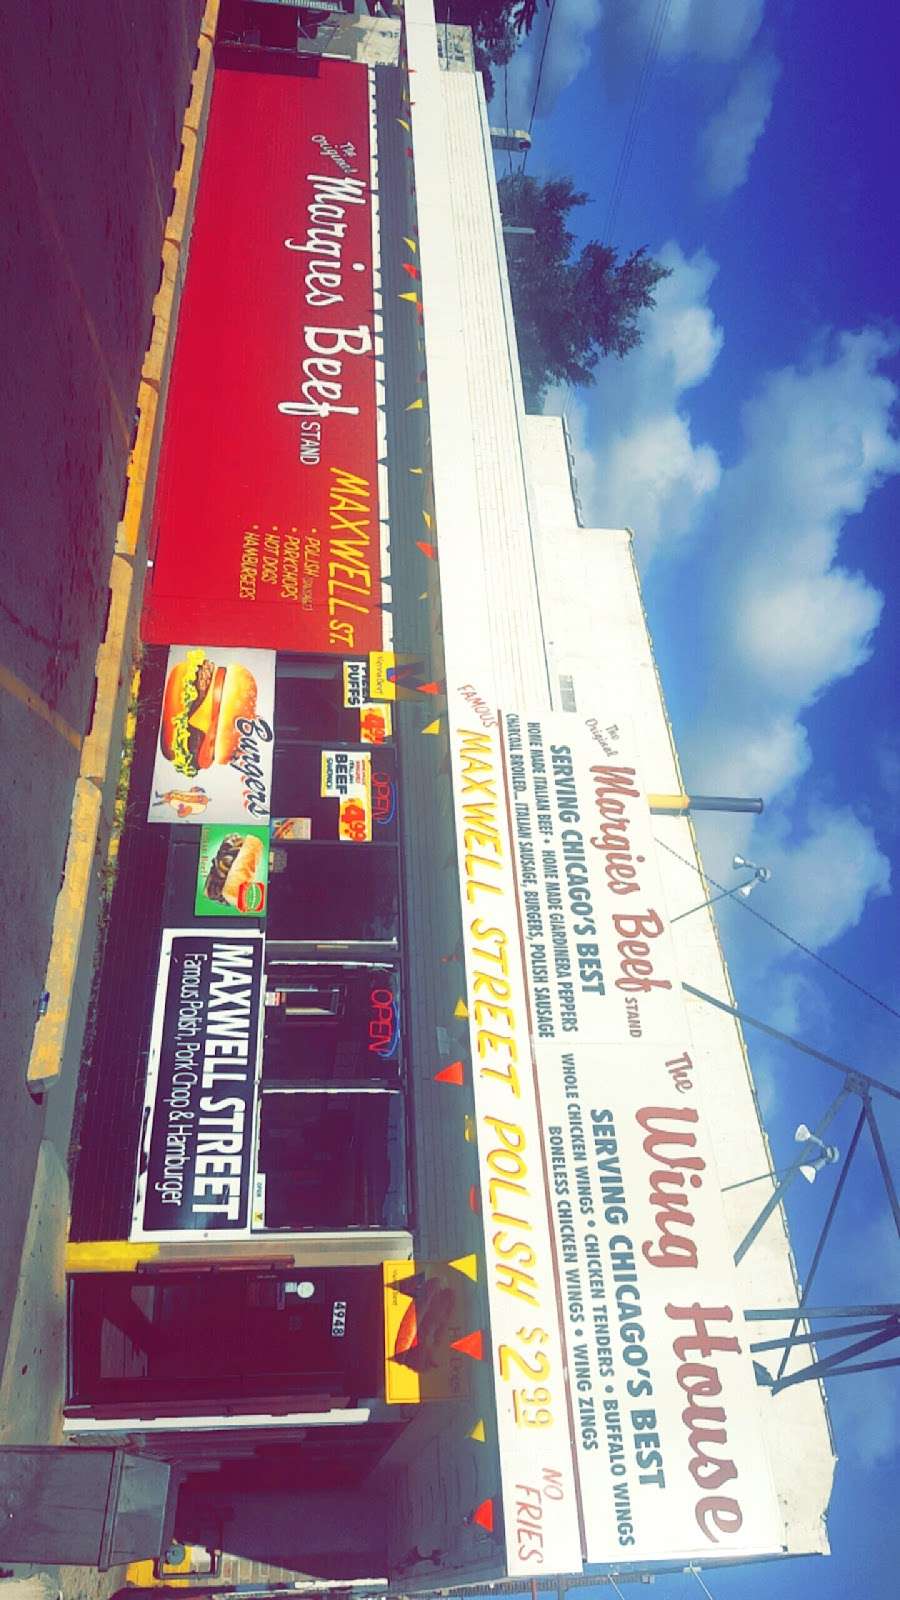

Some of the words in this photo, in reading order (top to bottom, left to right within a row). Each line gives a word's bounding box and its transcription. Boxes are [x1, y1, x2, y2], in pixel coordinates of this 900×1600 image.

[311, 134, 359, 173] Original
[284, 174, 367, 306] Margies
[277, 325, 372, 417] Beef
[300, 421, 321, 465] STAND
[239, 532, 260, 601] HAMBURGERS
[264, 533, 280, 556] HOT
[303, 536, 321, 577] POLISH
[327, 467, 371, 615] MAXWELL
[261, 556, 279, 585] DOGS
[280, 534, 301, 601] PORKCHOPS
[329, 619, 354, 648] ST.
[348, 665, 360, 705] PUFFS
[457, 684, 499, 728] FAMOUS
[505, 713, 521, 751] CHARCOAL
[527, 722, 542, 747] HOME
[585, 718, 619, 757] Original
[605, 724, 620, 740] The
[231, 718, 273, 818] Burgers
[335, 754, 348, 795] BEEF
[529, 749, 545, 774] MADE
[550, 744, 581, 823] SERVING
[372, 771, 390, 820] OPEN
[456, 728, 504, 904] MAXWELL
[533, 776, 550, 811] ITALIAN
[514, 803, 533, 839] ITALIAN
[537, 814, 553, 836] BEEF
[589, 765, 646, 895] Margies
[518, 841, 538, 888] SAUSAGE,
[542, 850, 560, 879] HOME
[561, 829, 597, 936] CHICAGO'S
[523, 891, 544, 941] BURGERS,
[545, 882, 563, 910] MADE
[529, 944, 549, 983] POLISH
[549, 913, 572, 978] GIARDINERA
[576, 943, 606, 996] BEST
[612, 908, 672, 993] Beef
[180, 954, 207, 998] Famous
[173, 1001, 204, 1041] Polish,
[201, 943, 254, 1088] MAXWELL
[368, 989, 393, 1052] OPEN
[470, 917, 521, 1098] STREET
[537, 987, 555, 1038] SAUSAGE
[557, 981, 578, 1033] PEPPERS
[625, 997, 642, 1038] STAND
[174, 1043, 200, 1069] Pork
[561, 1053, 579, 1099] WHOLE
[665, 1052, 693, 1094] The
[163, 1072, 197, 1107] Chop
[168, 1111, 192, 1121] &
[567, 1103, 586, 1161] CHICKEN
[154, 1124, 190, 1206] Hamburger
[191, 1097, 245, 1220] STREET
[548, 1126, 569, 1196] BONELESS
[590, 1109, 629, 1225] SERVING
[483, 1115, 540, 1308] POLISH
[575, 1166, 595, 1215] WINGS
[635, 1106, 706, 1269] Wing
[557, 1200, 578, 1263] CHICKEN
[584, 1234, 606, 1299] CHICKEN
[332, 1302, 345, 1336] 4948
[565, 1268, 584, 1323] WINGS
[609, 1235, 653, 1398] CHICAGO'S
[593, 1305, 615, 1377] TENDERS
[573, 1344, 592, 1391] WING
[578, 1397, 598, 1450] ZINGS
[603, 1400, 626, 1476] BUFFALO
[664, 1302, 743, 1544] House
[630, 1409, 665, 1489] BEST
[542, 1468, 564, 1501] NO
[514, 1484, 544, 1563] FRIES
[612, 1482, 635, 1546] WINGS
